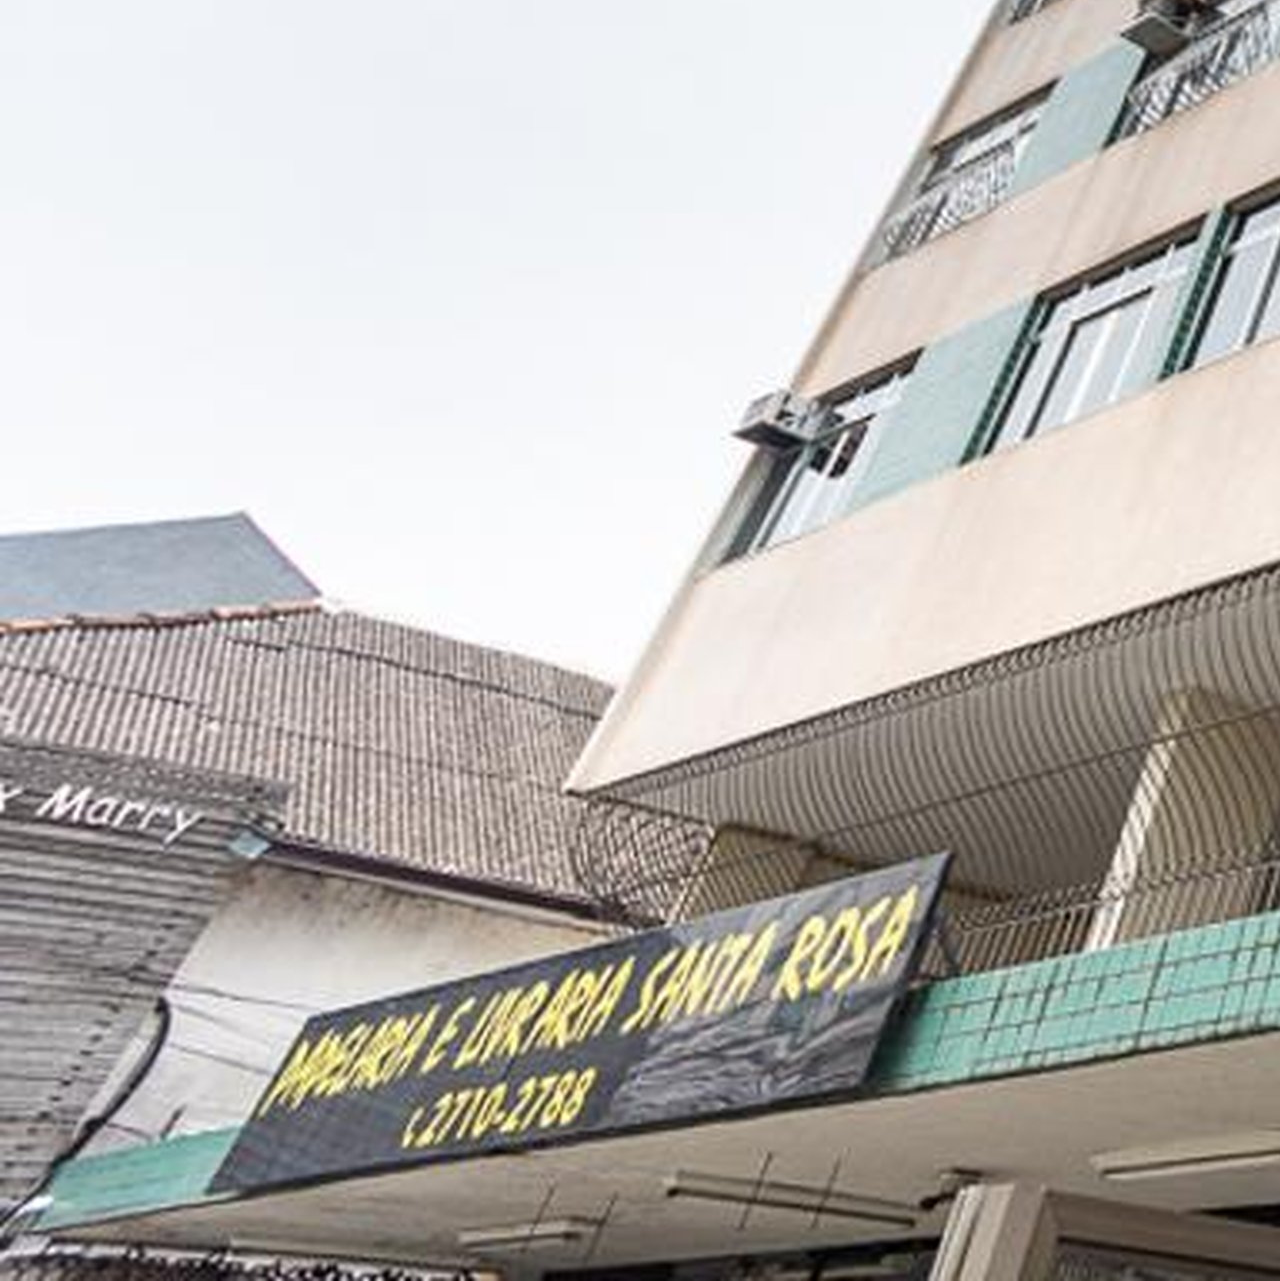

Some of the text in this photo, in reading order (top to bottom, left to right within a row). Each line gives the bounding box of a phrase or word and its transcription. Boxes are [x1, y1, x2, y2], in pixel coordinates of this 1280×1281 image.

[35, 782, 205, 852] Marry
[421, 996, 476, 1073] E
[619, 921, 779, 1034] SANTA
[770, 883, 918, 1002] ROSA
